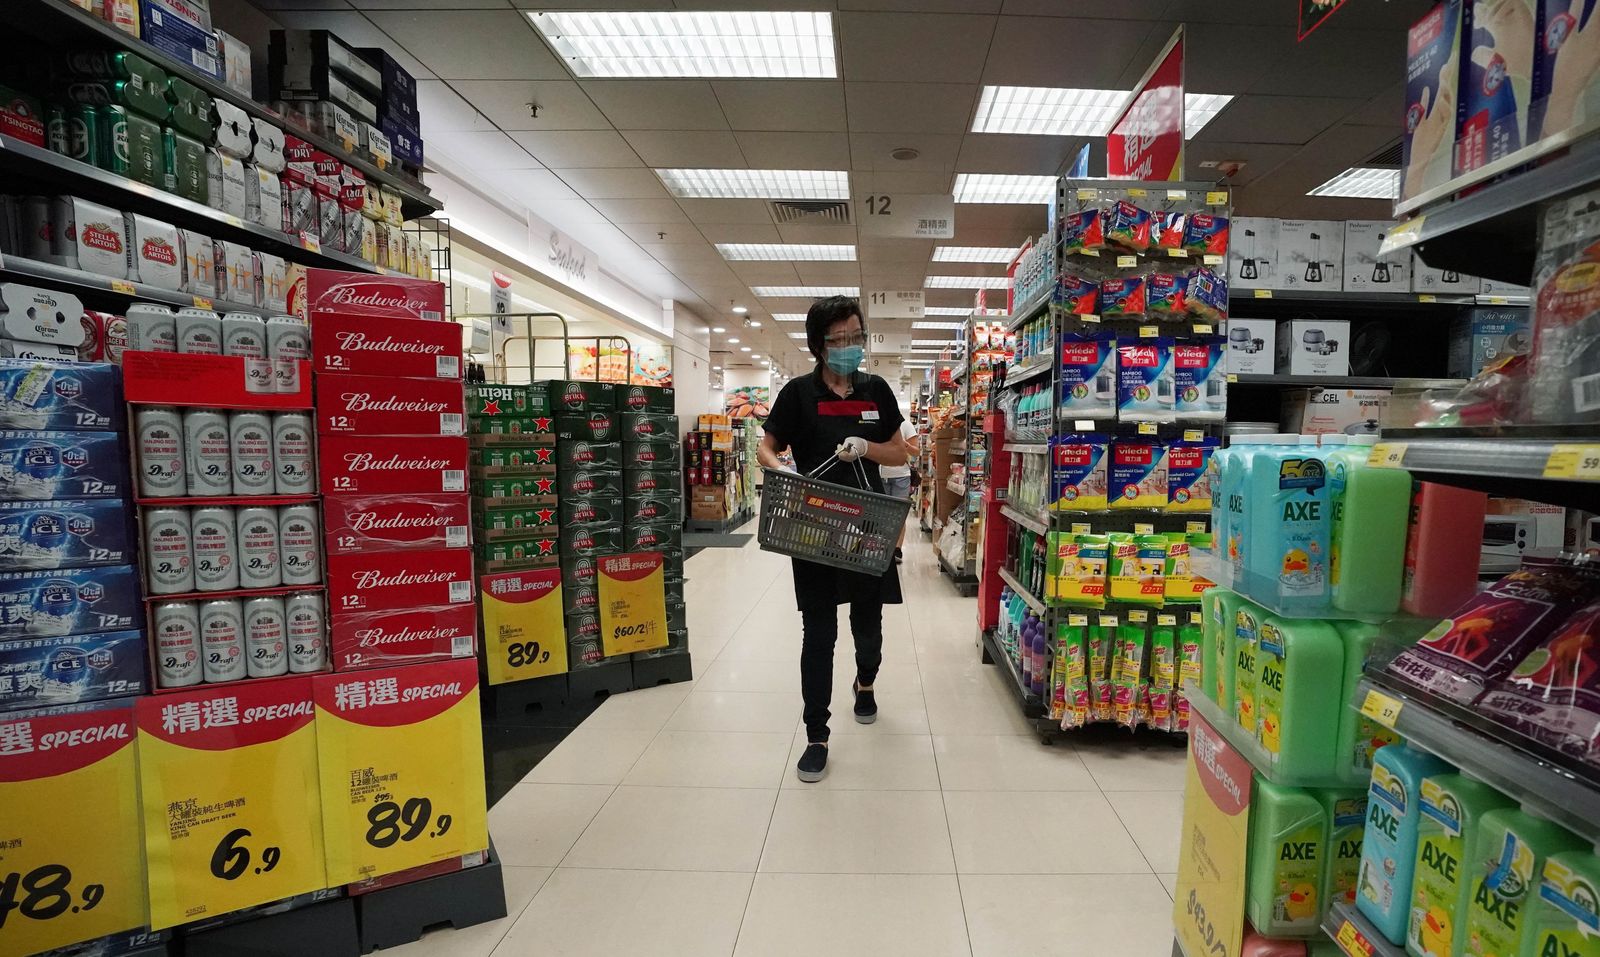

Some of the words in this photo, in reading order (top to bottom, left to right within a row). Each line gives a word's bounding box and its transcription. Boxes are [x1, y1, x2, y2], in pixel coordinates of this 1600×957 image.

[3, 116, 44, 136] TSINGTAO
[865, 195, 892, 216] 12
[917, 219, 948, 230] 酒精類
[89, 230, 116, 243] STELLA
[89, 237, 117, 250] ARTOIS
[147, 244, 171, 256] STELLA
[147, 250, 172, 262] ARTOIS
[328, 286, 428, 309] Budweiser
[871, 292, 886, 305] 11
[336, 331, 445, 355] Budweiser
[872, 334, 885, 344] 10
[1065, 347, 1095, 355] vileda
[1177, 350, 1207, 358] vileda
[324, 355, 343, 367] 12
[873, 359, 880, 367] 9
[340, 392, 448, 413] Budweiser
[1309, 393, 1340, 404] ECEL
[75, 412, 97, 426] 12
[329, 416, 348, 427] 12
[24, 455, 55, 465] ICE
[343, 452, 451, 472] Budweiser
[1169, 451, 1199, 459] vileda
[82, 481, 103, 494] 12
[332, 476, 351, 488] 12
[823, 500, 861, 516] wellcome
[1228, 494, 1243, 514] AXE
[1282, 500, 1321, 522] AXE
[1329, 501, 1343, 521] XE
[347, 511, 454, 531] Budweiser
[31, 524, 62, 534] ICE
[337, 536, 355, 547] 12
[88, 548, 109, 561] 12
[605, 557, 632, 573] 精選
[631, 559, 657, 570] SPECIAL
[351, 569, 457, 590] Budweiser
[490, 577, 523, 595] 精選
[522, 580, 555, 591] SPECIAL
[42, 592, 72, 603] ICE
[341, 594, 359, 606] 12
[98, 614, 119, 627] 12
[355, 625, 460, 648] Budweiser
[344, 653, 363, 664] 12
[507, 641, 551, 668] 89.9
[1238, 650, 1256, 674] AXE
[52, 659, 82, 672] ICE
[107, 679, 127, 693] 12
[1261, 665, 1283, 692] AXE
[334, 677, 399, 712] 精選
[401, 682, 463, 703] SPECIAL
[161, 696, 240, 735] 精選
[242, 700, 315, 725] SPECIAL
[38, 722, 129, 752] SPECIAL
[1214, 763, 1242, 807] SPECIAL
[365, 796, 453, 849] 89.9
[1369, 803, 1400, 843] AXE
[210, 827, 281, 881] 6.9
[1280, 842, 1317, 861] AXE
[1337, 840, 1363, 859] AX
[1421, 840, 1458, 885] AXE
[129, 933, 148, 947] 12
